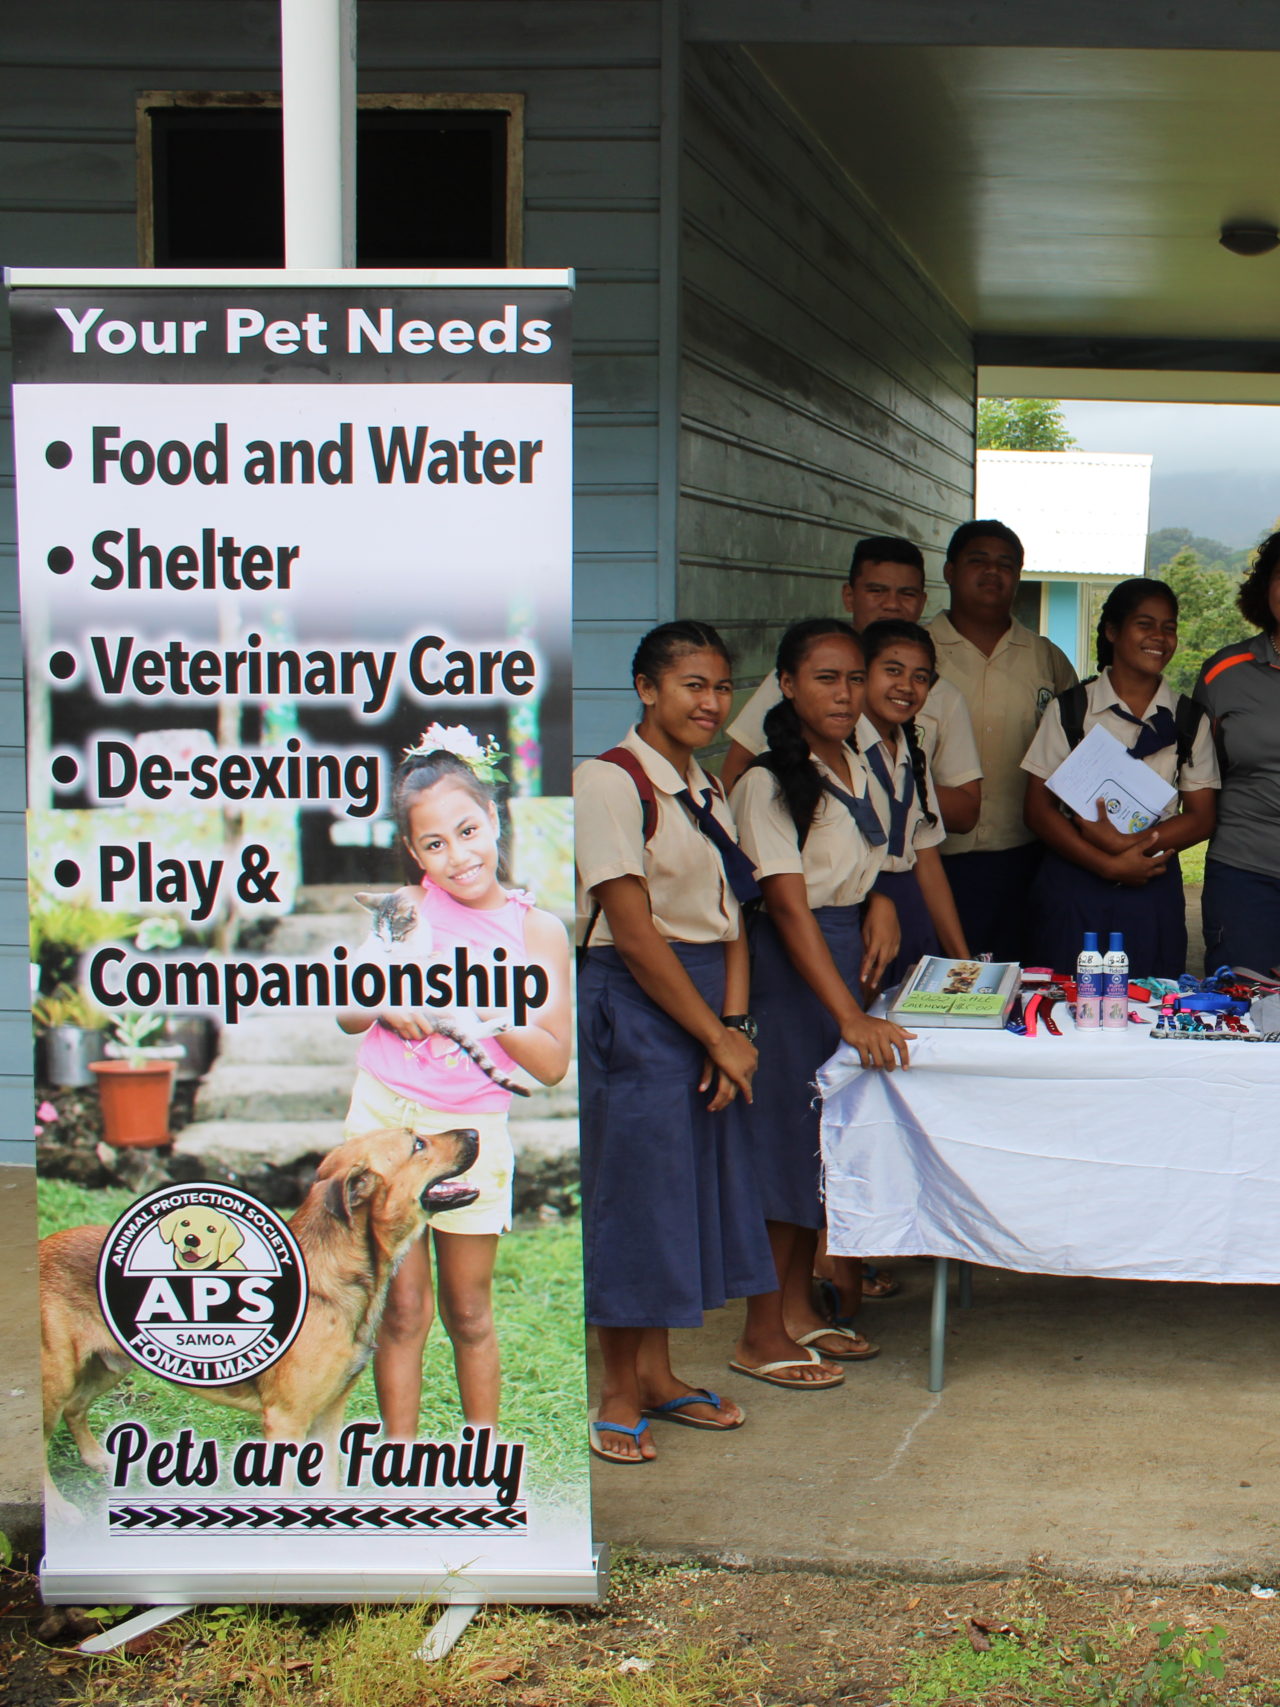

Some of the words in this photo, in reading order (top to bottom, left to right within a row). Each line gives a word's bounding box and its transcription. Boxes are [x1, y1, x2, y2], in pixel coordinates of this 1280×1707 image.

[55, 307, 206, 354] Your
[226, 307, 327, 354] Pet
[347, 305, 552, 354] Needs
[92, 423, 229, 485] Food
[244, 423, 353, 485] and
[368, 425, 543, 484] Water
[90, 528, 300, 591] Shelter
[91, 633, 396, 713] Veterinary
[409, 635, 536, 696] Care
[97, 738, 380, 817] De-sexing
[99, 842, 224, 921] Play
[236, 844, 281, 903] &
[90, 947, 549, 1026] Companionship
[112, 1212, 152, 1266] ANIMAL
[151, 1192, 245, 1216] PROTECTION
[247, 1208, 292, 1266] SOCIETY
[134, 1276, 275, 1323] APS
[129, 1333, 209, 1379] FOMA'I
[215, 1334, 280, 1379] MANU
[176, 1333, 236, 1346] SAMOA
[106, 1422, 219, 1488] Pets
[233, 1440, 323, 1488] are
[339, 1422, 525, 1507] Family
